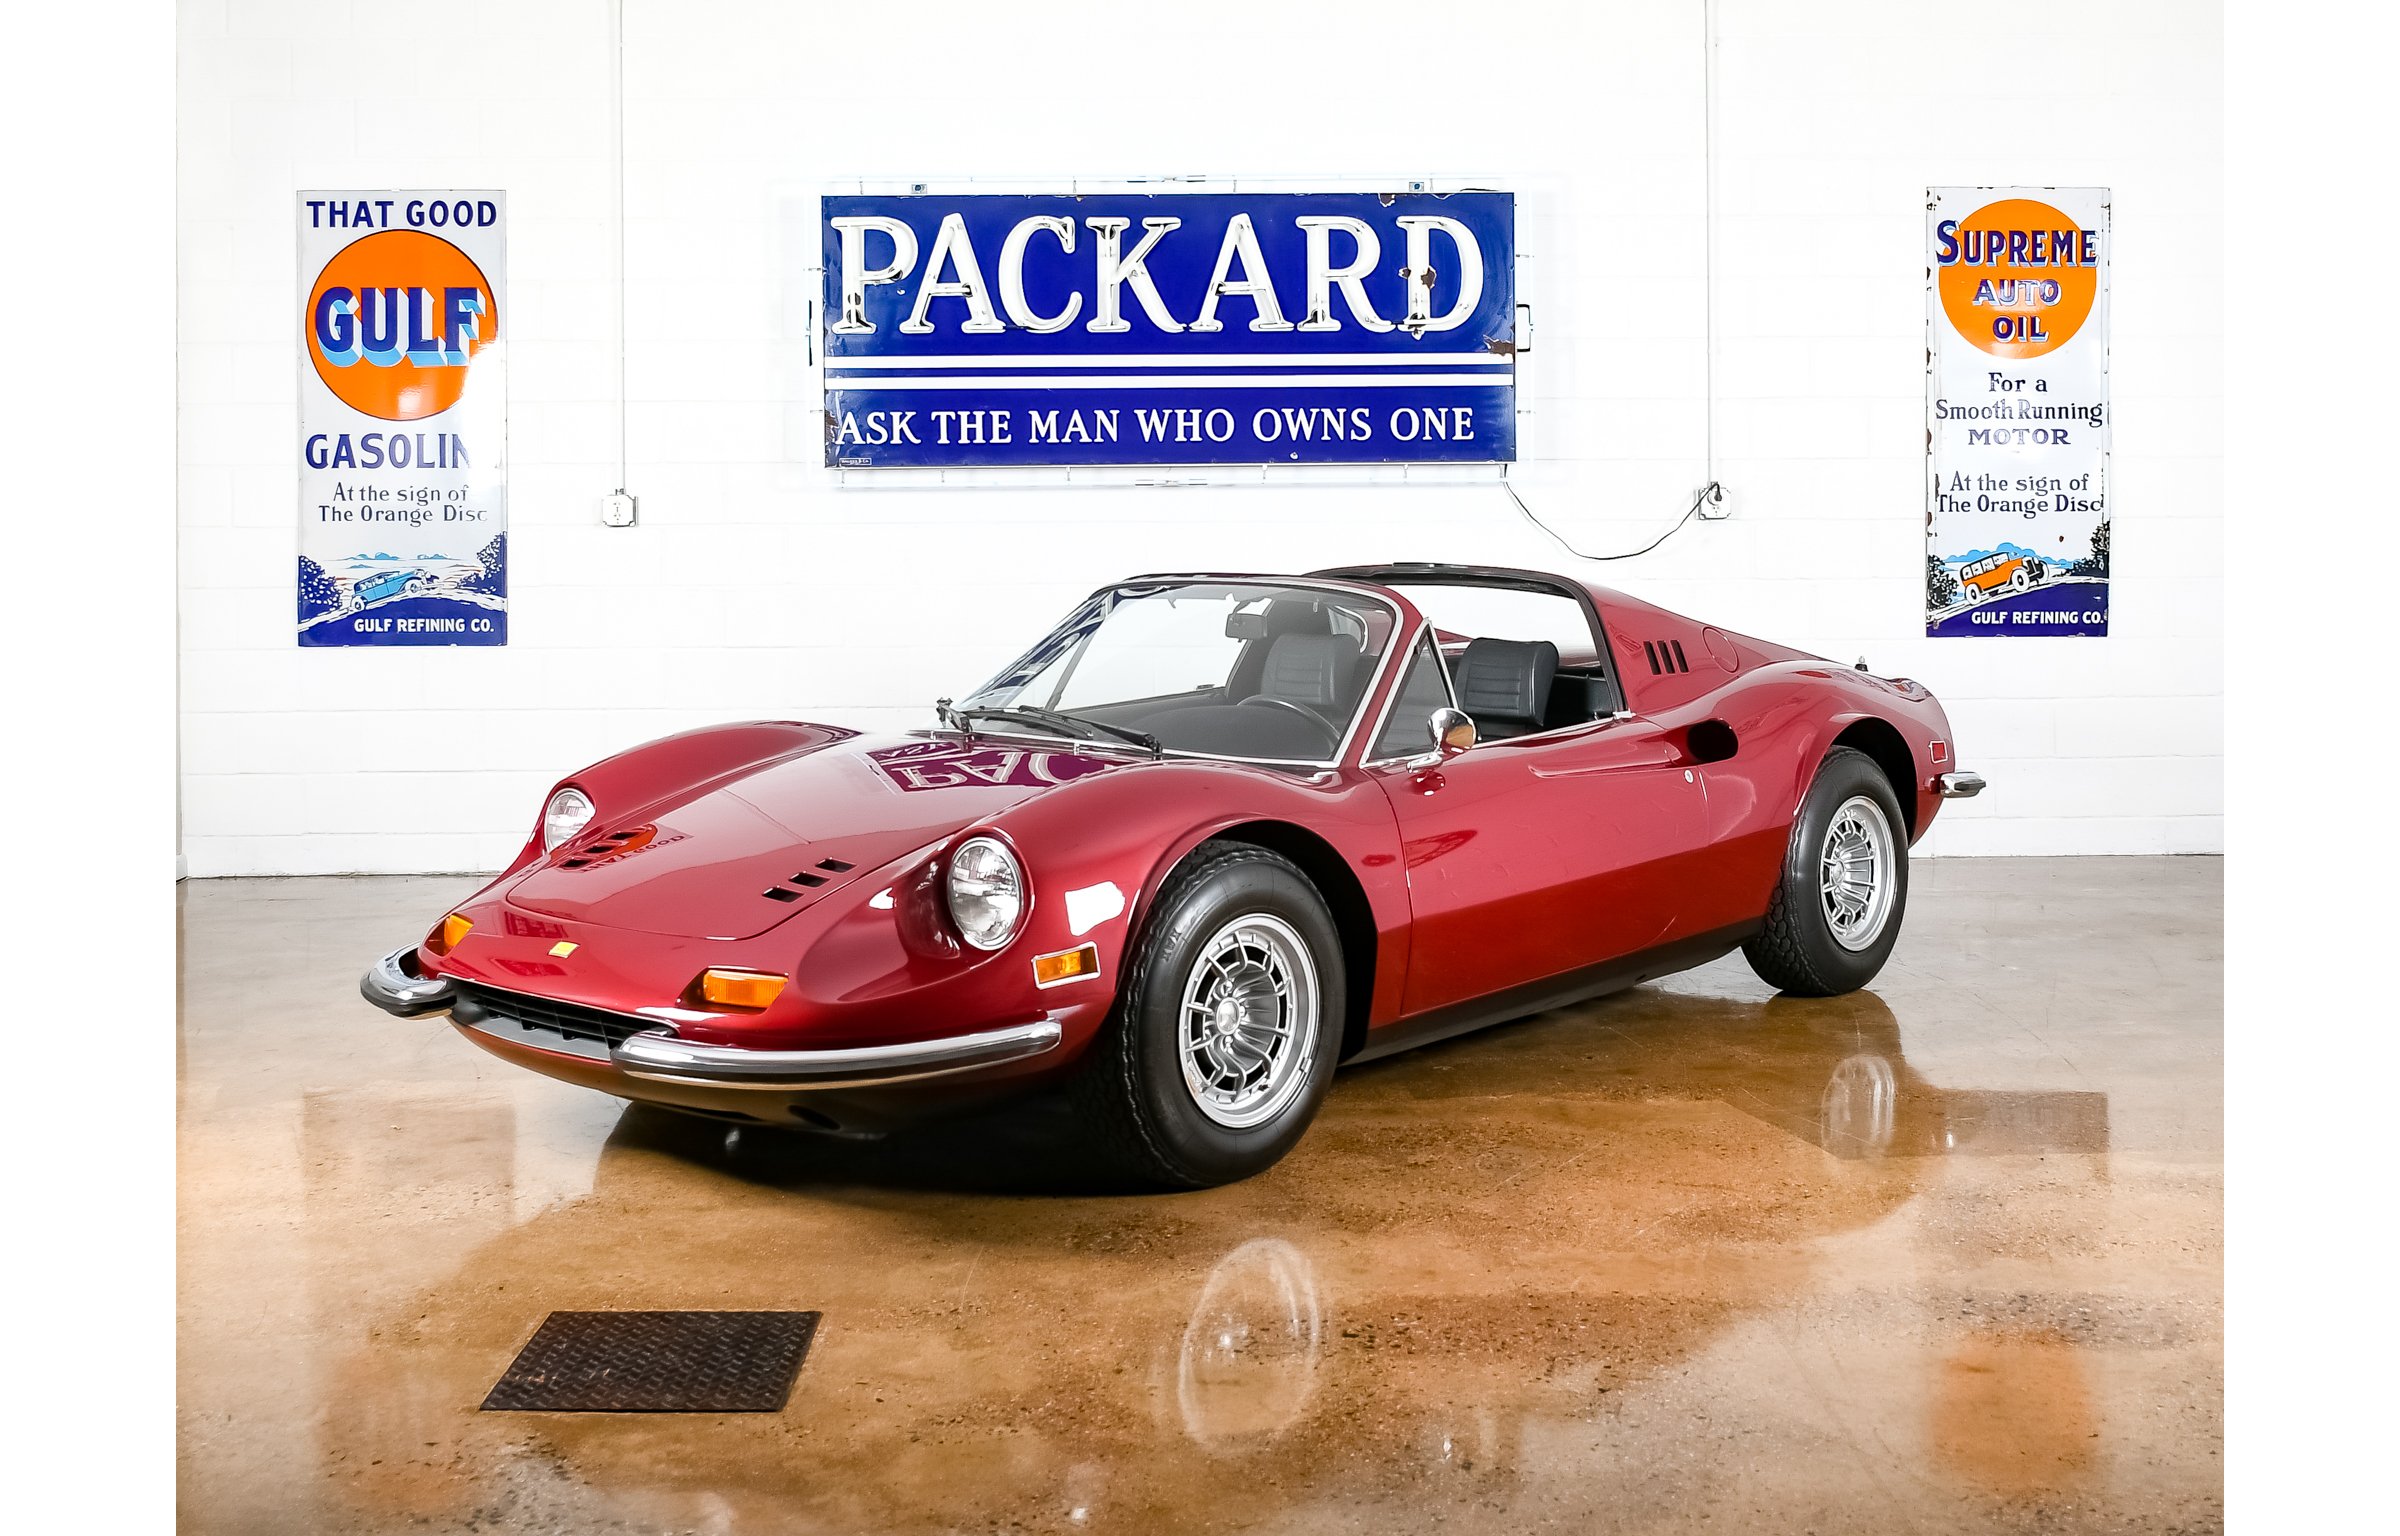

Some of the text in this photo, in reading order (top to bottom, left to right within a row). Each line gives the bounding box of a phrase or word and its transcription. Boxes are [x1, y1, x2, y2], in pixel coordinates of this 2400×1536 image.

[305, 199, 498, 229] THAT GOOD
[1935, 219, 2100, 268] SUPREME
[830, 212, 1486, 338] PACKARD
[1971, 278, 2062, 307] AUTO
[315, 286, 487, 368] GULF
[1992, 315, 2050, 343] OIL
[1987, 371, 2048, 393] For a
[834, 407, 1476, 445] ASK THE MAN WHO OWNS ONE
[1935, 398, 2103, 429] Smooth Running
[305, 432, 471, 470] GASOLIN
[1967, 428, 2072, 446] MOTOR
[332, 481, 470, 507] At the sign of
[1949, 470, 2090, 497] At the sign of
[318, 504, 489, 528] The Orange Disc
[1939, 493, 2102, 520] The Orange Disc
[354, 618, 495, 634] GULF REFINING CO.
[1971, 611, 2105, 625] GULF REFINING CO.
